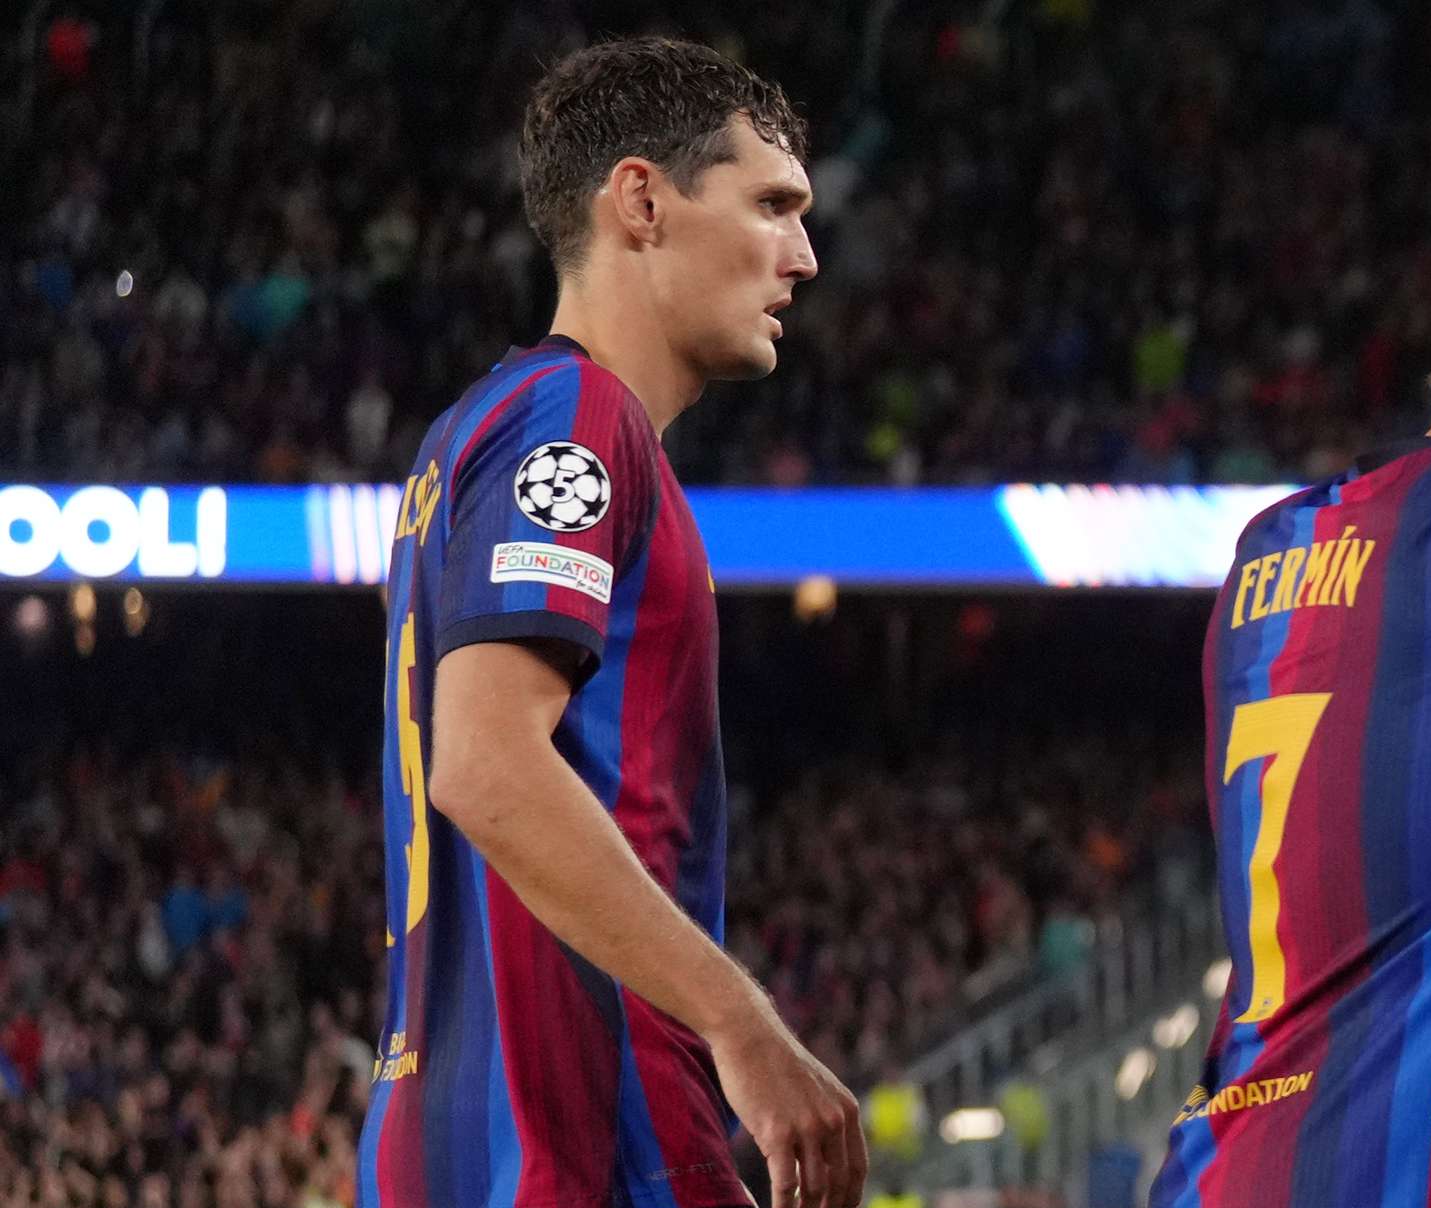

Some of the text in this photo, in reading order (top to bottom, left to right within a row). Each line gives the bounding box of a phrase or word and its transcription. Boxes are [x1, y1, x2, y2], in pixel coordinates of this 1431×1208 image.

[551, 468, 577, 504] 5
[496, 555, 611, 592] FOUNDATION
[1230, 525, 1377, 630] FERMÍN
[1223, 692, 1333, 1024] 7
